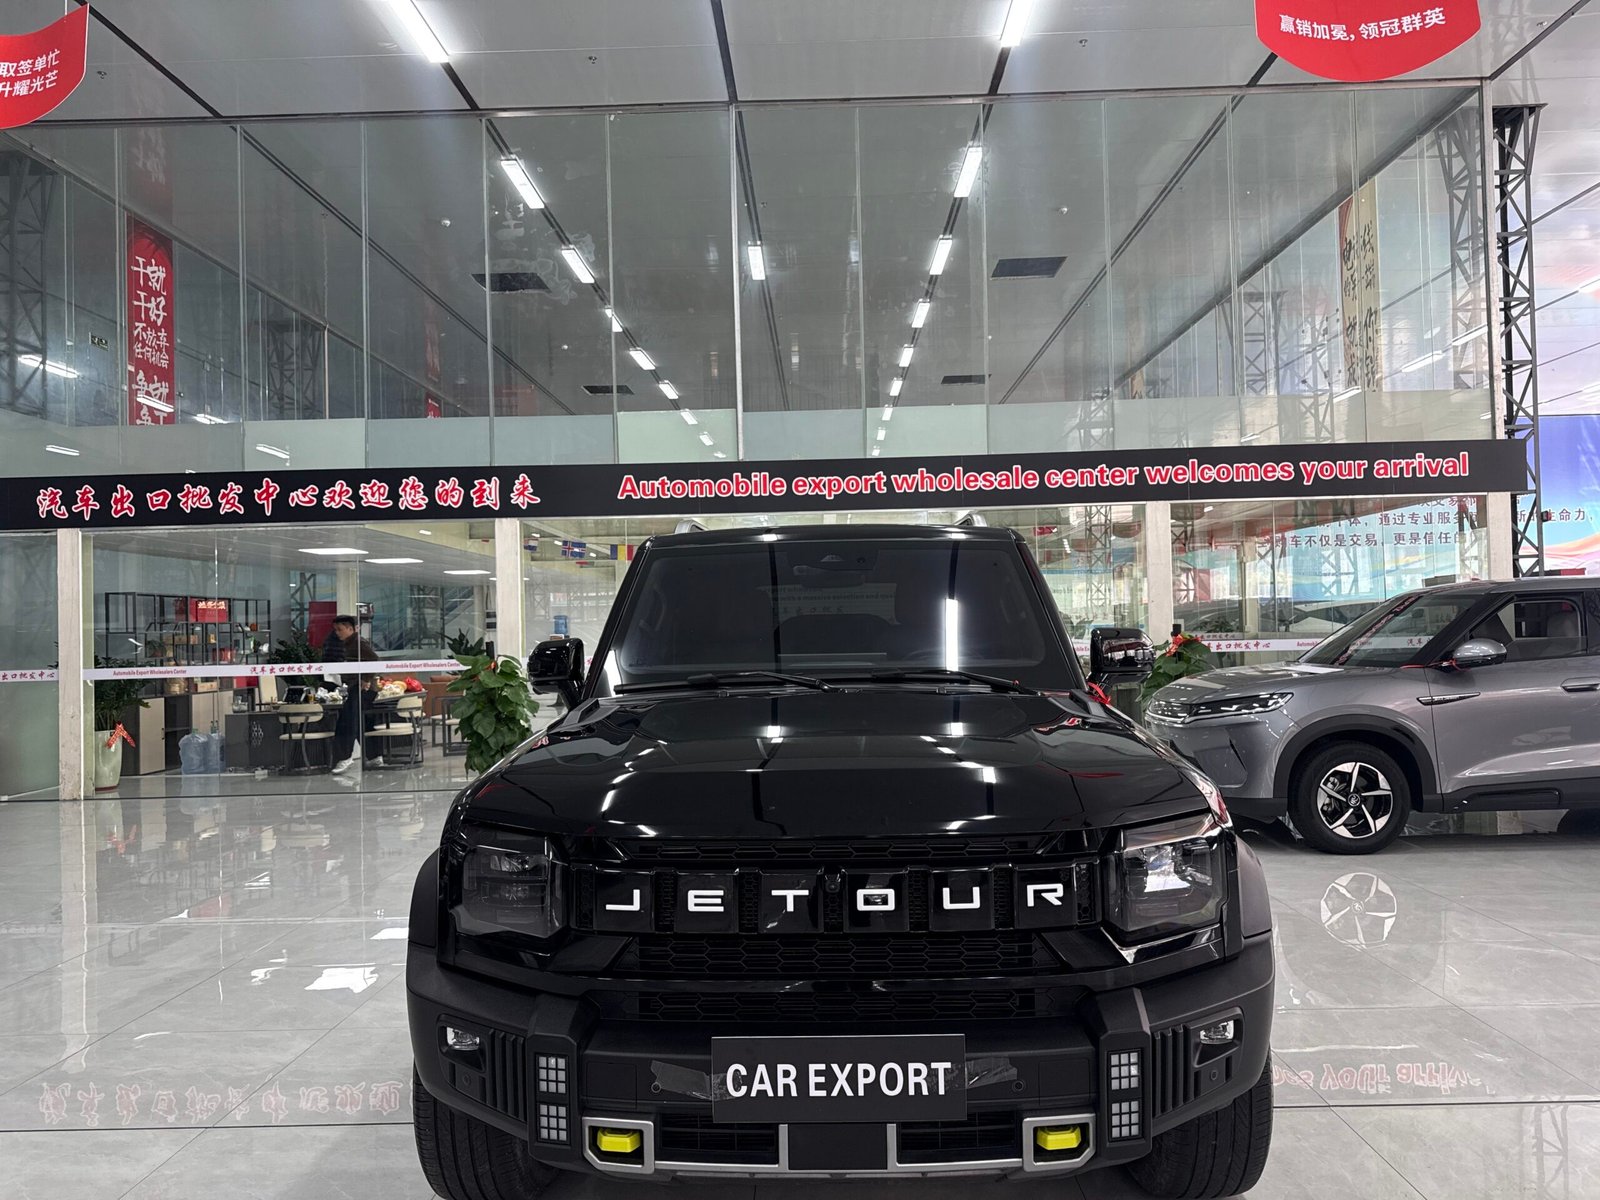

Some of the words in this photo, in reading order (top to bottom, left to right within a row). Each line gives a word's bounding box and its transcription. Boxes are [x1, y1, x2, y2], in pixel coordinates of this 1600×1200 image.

[1279, 7, 1446, 41] 赢销加冕，领冠群英
[617, 472, 787, 500] Automobile
[791, 470, 887, 499] export
[890, 465, 1039, 493] wholesale
[1043, 462, 1138, 489] center
[1142, 457, 1295, 485] welcomes
[1299, 456, 1368, 487] your
[1372, 450, 1470, 480] arrival
[36, 473, 542, 521] 汽车出口批发中心欢迎您的到来
[605, 883, 1064, 912] JETOUR
[726, 1063, 798, 1098] CAR
[808, 1061, 951, 1097] EXPORT
